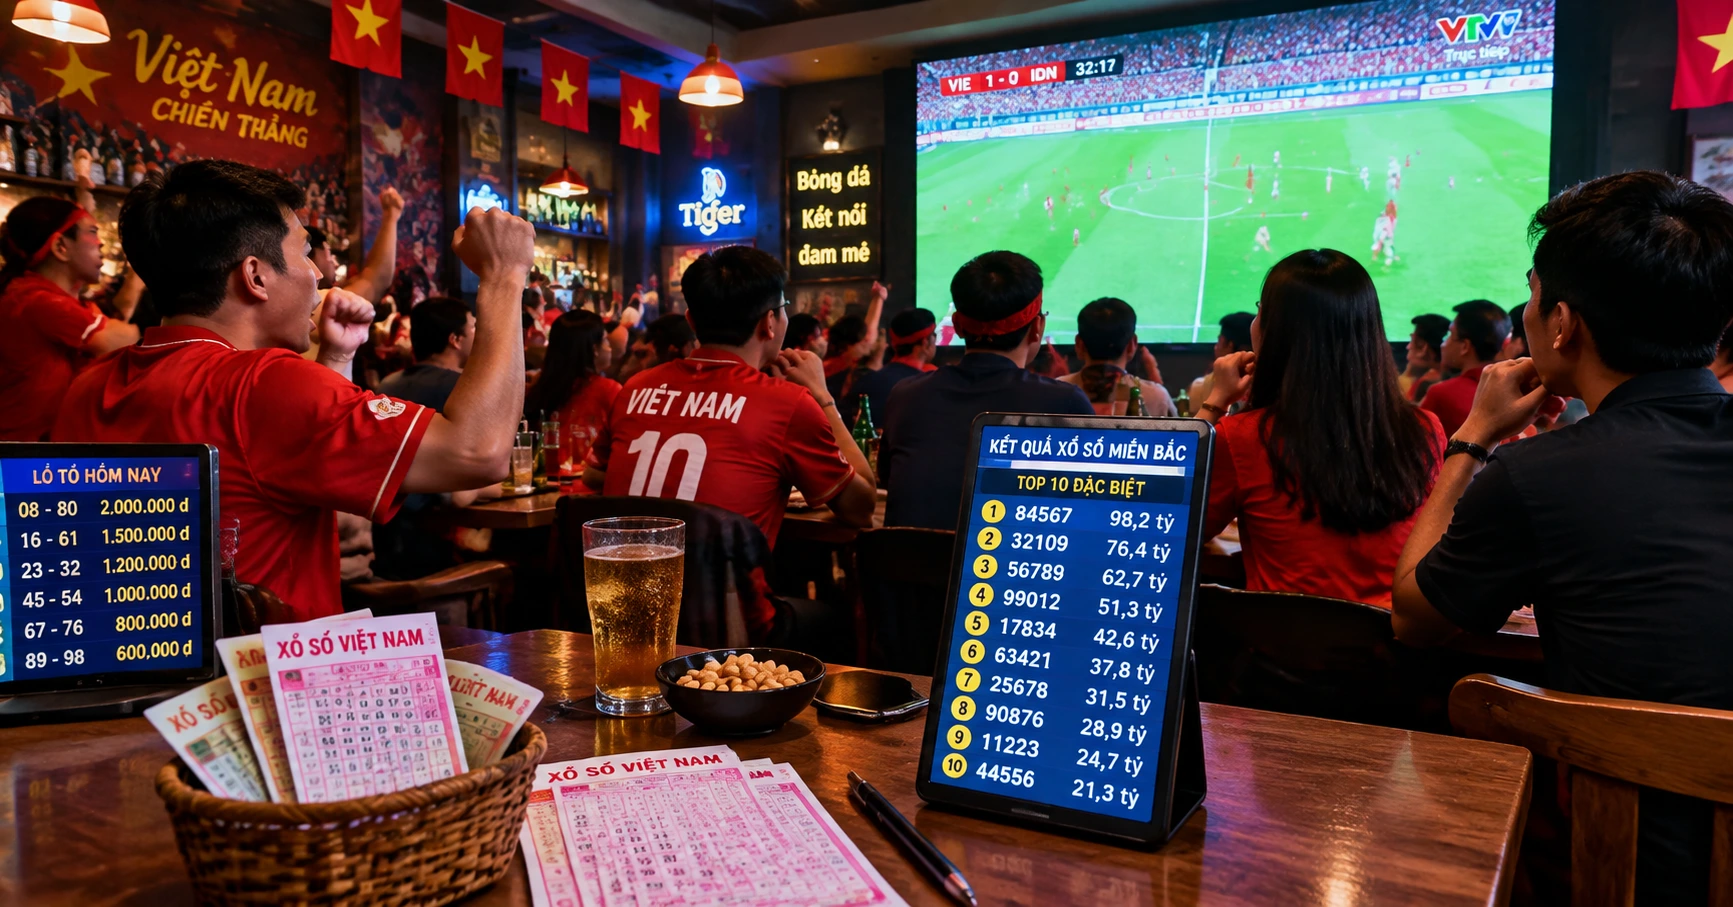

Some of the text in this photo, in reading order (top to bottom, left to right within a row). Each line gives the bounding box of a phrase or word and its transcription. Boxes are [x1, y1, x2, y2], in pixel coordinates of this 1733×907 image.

[127, 28, 318, 117] Việt Nam
[948, 77, 971, 92] VIE
[985, 74, 993, 88] 1
[1008, 71, 1019, 85] 0
[1030, 65, 1058, 82] IDN
[1075, 58, 1117, 77] 32:17
[678, 199, 746, 236] Tiger
[680, 391, 747, 424] NAM
[127, 466, 162, 483] NAY
[627, 430, 708, 502] 10
[1017, 475, 1046, 491] TOP
[1050, 477, 1069, 492] 10
[18, 501, 40, 518] 08
[56, 500, 78, 516] 80
[990, 504, 998, 518] 1
[1014, 505, 1073, 524] 84567
[1109, 509, 1150, 532] 98,2
[20, 531, 42, 549] 16
[58, 530, 78, 546] 61
[101, 525, 177, 545] 1.500.000
[984, 531, 995, 546] 2
[1010, 532, 1069, 552] 32109
[1106, 539, 1148, 560] 76,4
[21, 562, 43, 579] 23
[59, 560, 81, 577] 32
[102, 554, 178, 574] 1.200.000
[980, 559, 990, 574] 3
[1007, 560, 1065, 581] 56789
[1102, 569, 1144, 590] 62,7
[22, 591, 45, 608] 45
[61, 589, 83, 606] 54
[104, 583, 179, 604] 1.000.000
[975, 587, 986, 603] 4
[1003, 588, 1061, 611] 99012
[1098, 598, 1139, 620] 51,3
[24, 621, 46, 639] 67
[62, 619, 84, 636] 76
[115, 611, 179, 632] 800.000
[382, 628, 424, 648] NAM
[972, 615, 982, 631] 5
[1000, 617, 1057, 640] 17834
[1093, 628, 1136, 651] 42,6
[25, 651, 47, 669] 89
[63, 649, 85, 666] 98
[967, 644, 977, 659] 6
[994, 646, 1052, 670] 63421
[1089, 657, 1131, 681] 37,8
[963, 672, 974, 687] 7
[989, 675, 1049, 700] 25678
[1085, 687, 1128, 711] 31,5
[958, 701, 969, 716] 8
[985, 703, 1045, 729] 90876
[1080, 717, 1123, 742] 28,9
[673, 754, 723, 768] NAM
[954, 730, 965, 745] 9
[982, 732, 1040, 759] 11223
[1076, 748, 1120, 773] 24,7
[947, 758, 964, 773] 10
[975, 761, 1035, 789] 44556
[1071, 778, 1115, 803] 21,3
